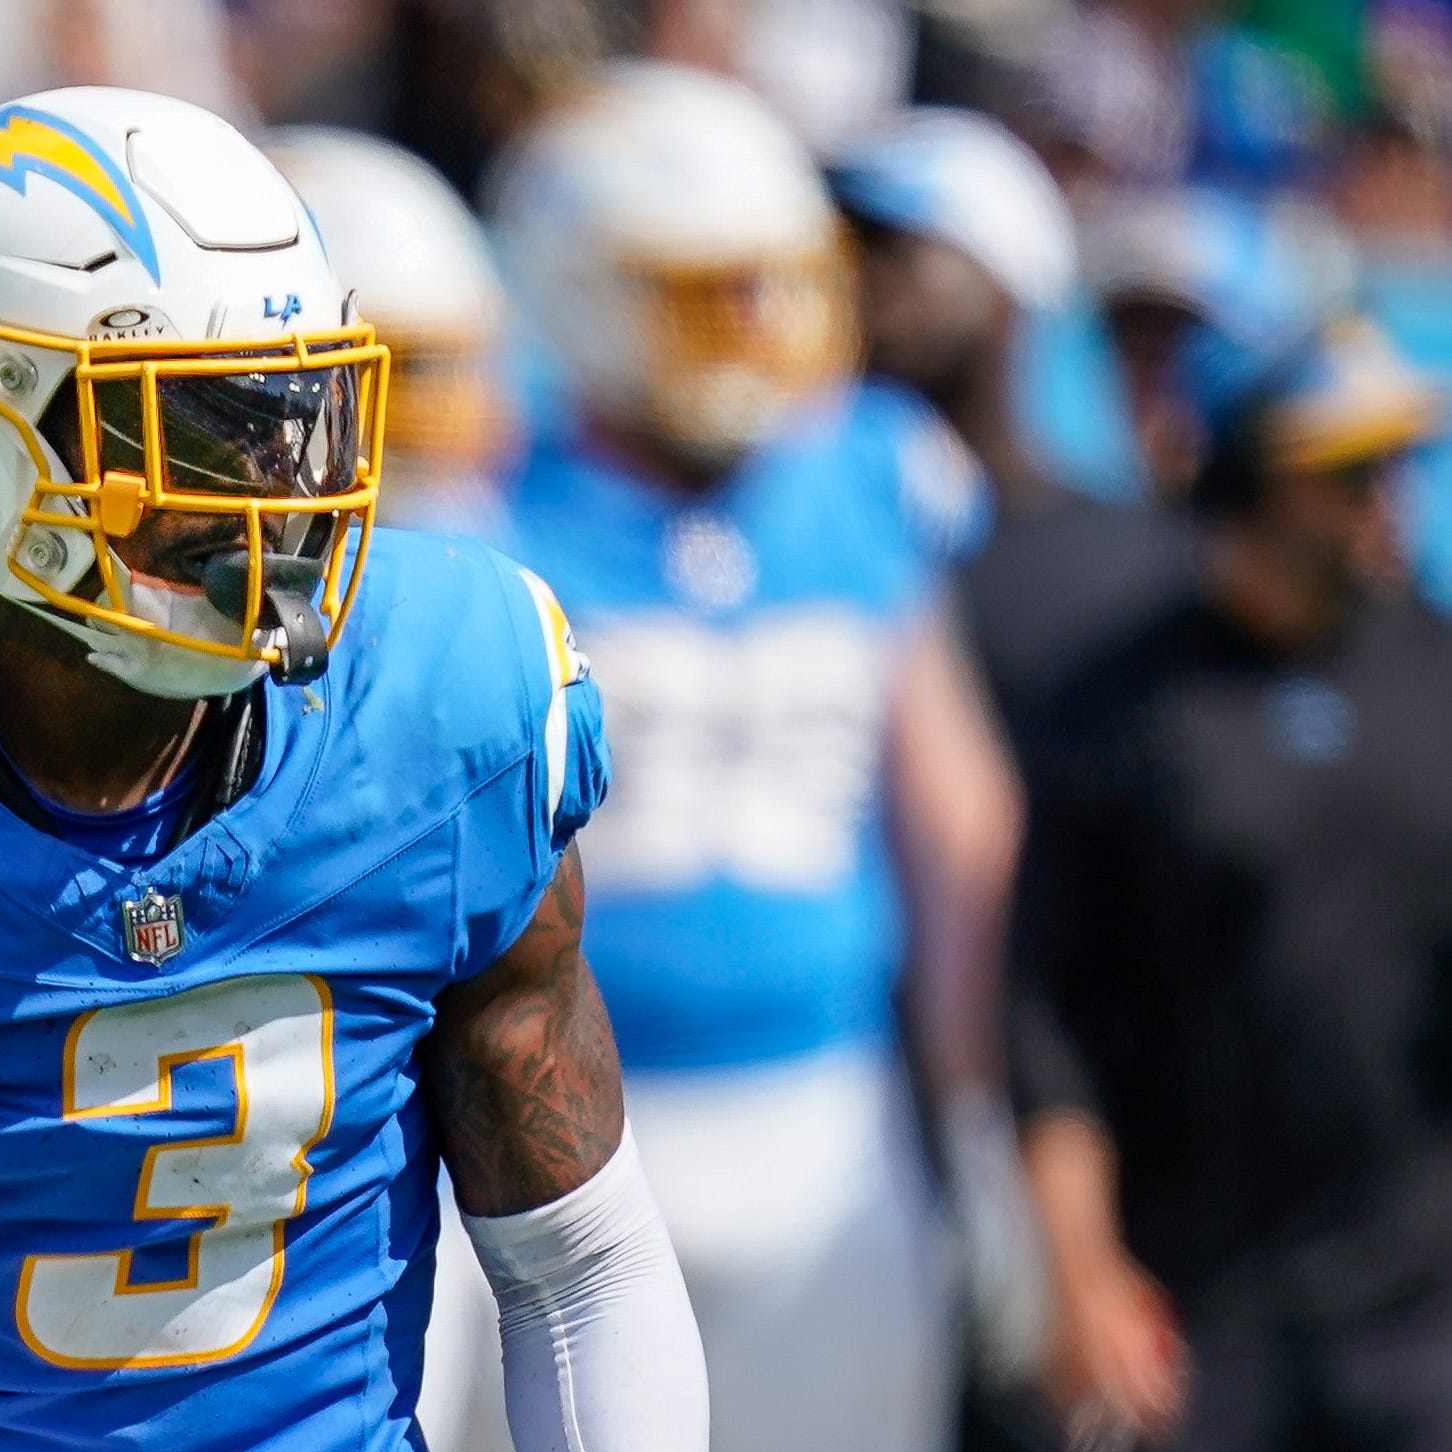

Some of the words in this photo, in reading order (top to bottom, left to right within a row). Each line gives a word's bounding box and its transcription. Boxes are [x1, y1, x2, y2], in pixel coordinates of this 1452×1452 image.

[262, 293, 302, 330] LA
[136, 923, 177, 953] NFL
[14, 971, 336, 1371] 3
